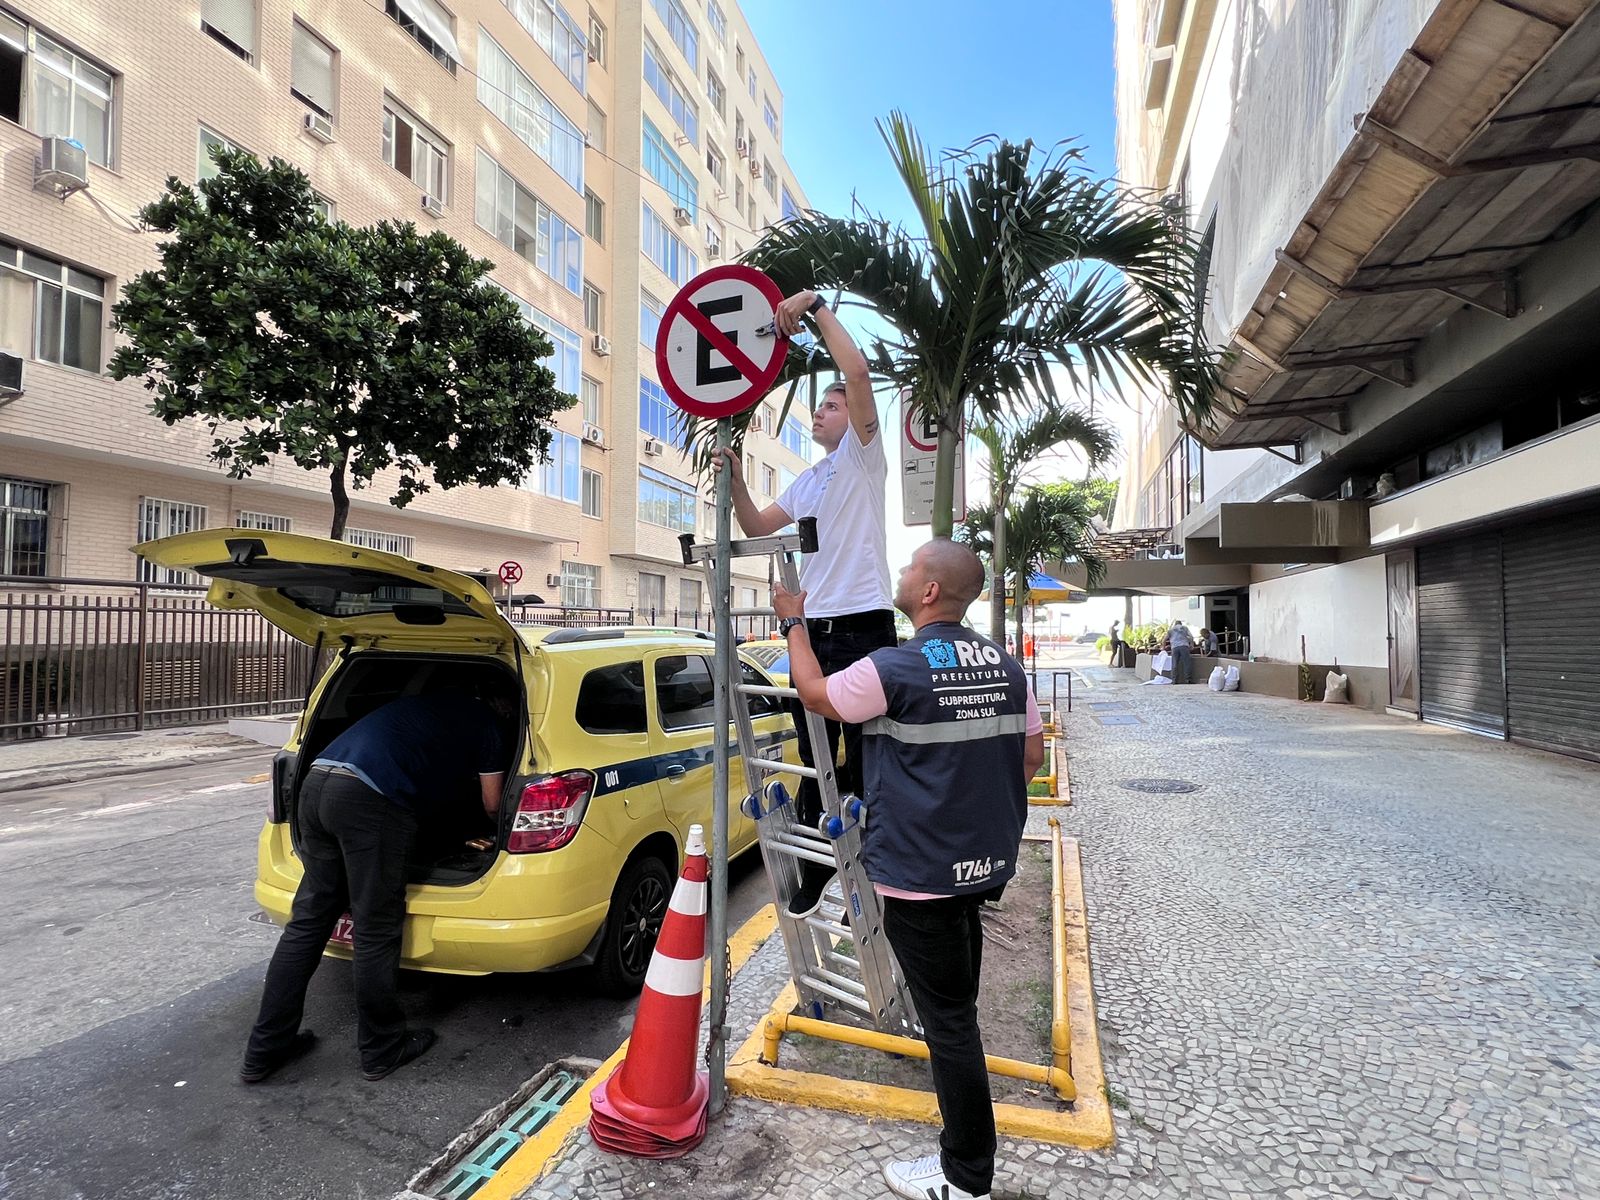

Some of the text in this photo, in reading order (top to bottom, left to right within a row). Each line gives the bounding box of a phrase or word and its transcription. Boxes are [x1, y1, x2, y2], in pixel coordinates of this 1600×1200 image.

[696, 295, 743, 386] E
[953, 641, 1001, 667] Rio
[932, 670, 1007, 682] PREFEITURA
[938, 692, 1006, 706] SUBPREFEITURA
[955, 707, 996, 719] ZONA SUL
[604, 770, 620, 788] 001
[952, 856, 992, 881] 1746
